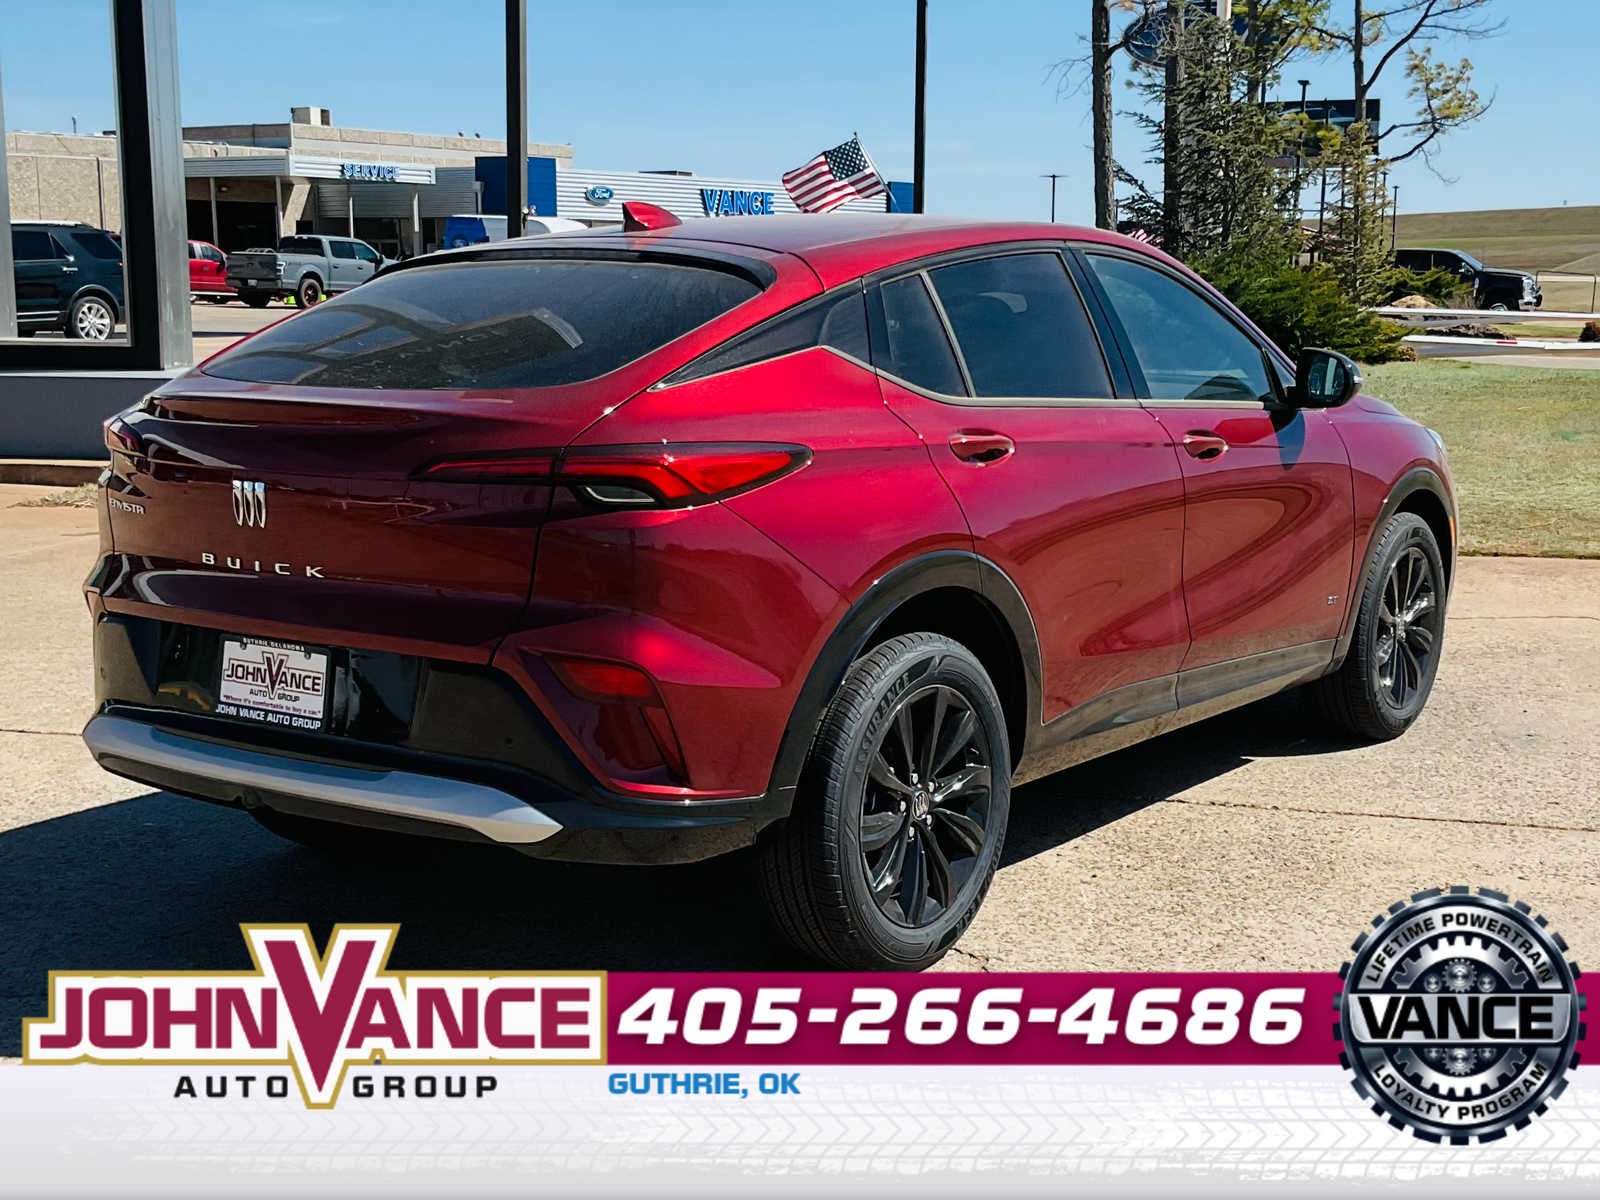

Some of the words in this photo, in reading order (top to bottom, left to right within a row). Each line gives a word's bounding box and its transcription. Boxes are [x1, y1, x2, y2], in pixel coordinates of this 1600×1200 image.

[343, 162, 400, 178] SERVICE
[702, 189, 775, 216] VANCE
[202, 552, 325, 579] BUICK
[226, 662, 267, 684] JOHN
[266, 656, 321, 694] VANCE
[249, 688, 267, 698] AUTO
[277, 694, 300, 702] GROUP
[215, 704, 237, 716] JOHN
[239, 708, 265, 720] VANCE
[266, 713, 290, 725] AUTO
[291, 718, 321, 730] GROUP
